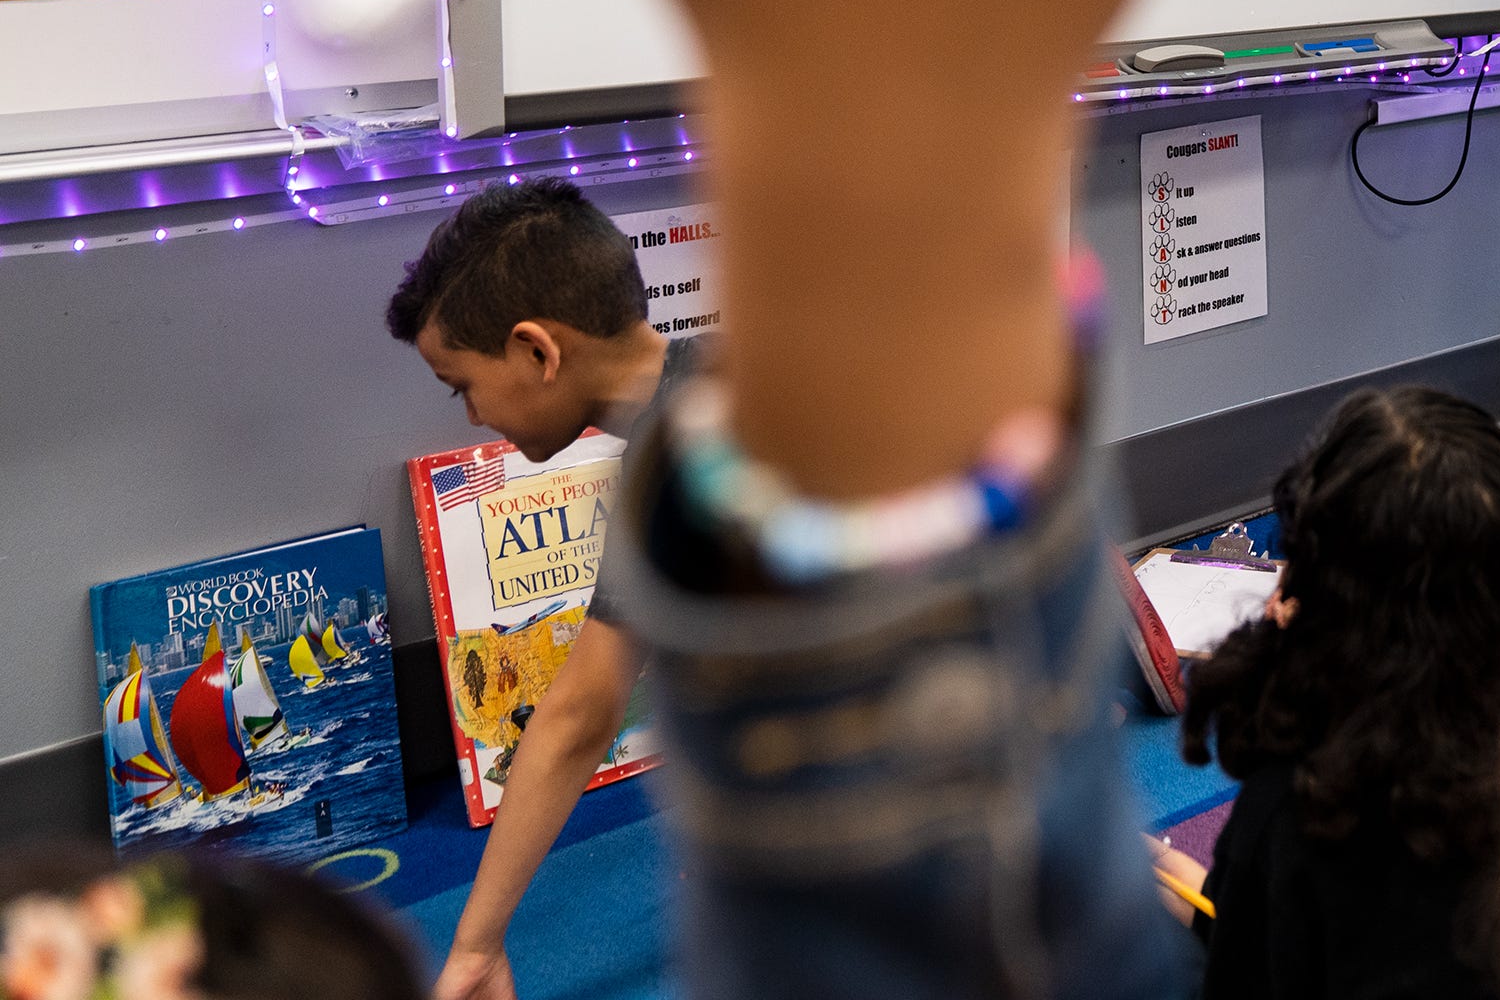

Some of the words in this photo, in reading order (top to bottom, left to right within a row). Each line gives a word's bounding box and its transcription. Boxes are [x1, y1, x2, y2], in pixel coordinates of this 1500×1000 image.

[1167, 141, 1207, 159] Cougars
[1208, 134, 1239, 152] SLANT!
[1158, 187, 1165, 201] S
[1176, 187, 1183, 199] it
[1184, 186, 1194, 199] up
[1160, 218, 1165, 231] L
[1176, 214, 1197, 227] isten
[641, 231, 666, 248] the
[1160, 249, 1167, 261] A
[1177, 248, 1187, 259] sk
[1188, 246, 1194, 256] &
[1195, 240, 1223, 255] answer
[1224, 232, 1261, 250] questions
[662, 283, 674, 298] to
[678, 278, 701, 294] self
[1160, 279, 1167, 292] N
[1178, 277, 1188, 288] od
[1190, 273, 1208, 287] your
[1210, 267, 1229, 281] head
[1161, 310, 1167, 323] T
[1178, 304, 1196, 318] rack
[1198, 299, 1211, 313] the
[1212, 293, 1244, 313] speaker
[673, 309, 720, 333] forward
[550, 473, 573, 487] THE
[486, 489, 556, 518] YOUNG
[495, 496, 611, 560] ATLA
[547, 549, 566, 563] OF
[570, 541, 600, 557] THE
[167, 566, 318, 619] DISCOVERY
[178, 575, 227, 596] WORLD
[228, 567, 264, 585] BOOK
[499, 563, 580, 601] UNITED
[168, 585, 329, 636] ENCYCLOPEDIA
